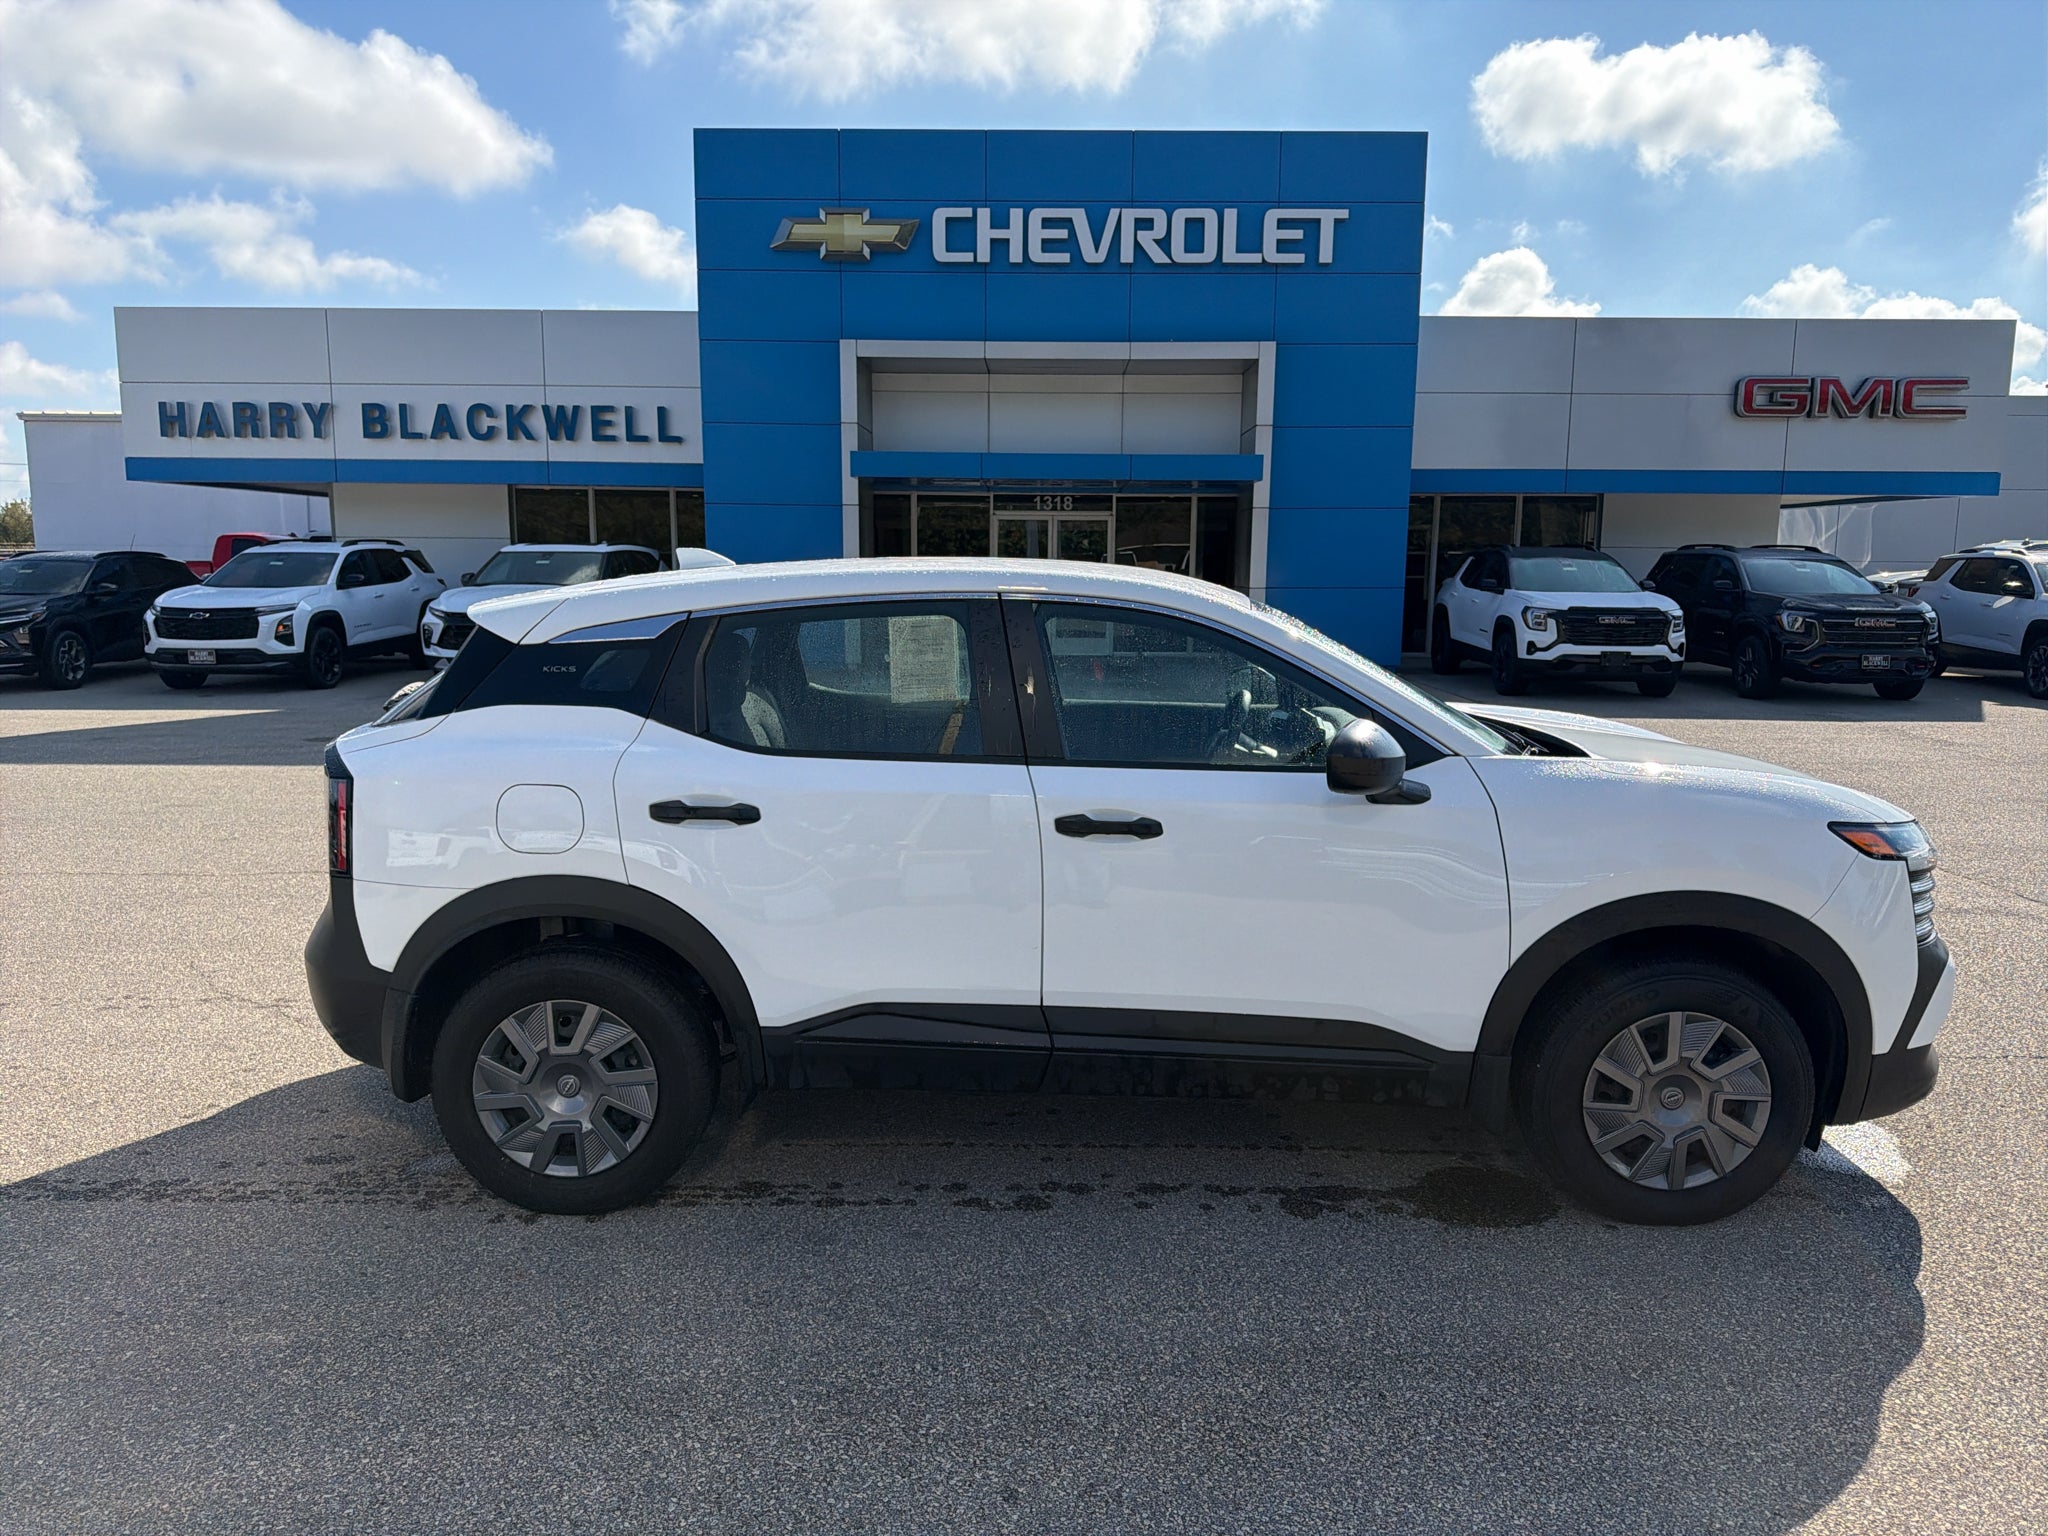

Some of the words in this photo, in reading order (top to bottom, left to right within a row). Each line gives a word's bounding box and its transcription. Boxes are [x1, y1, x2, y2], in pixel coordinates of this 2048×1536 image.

[931, 207, 1350, 265] CHEVROLET
[1736, 375, 1970, 419] GMC
[158, 401, 330, 440] HARRY
[361, 402, 684, 444] BLACKWELL
[1033, 495, 1073, 511] 1318
[1598, 616, 1637, 625] GMC
[1857, 617, 1897, 627] GMC
[542, 665, 577, 673] KICKS
